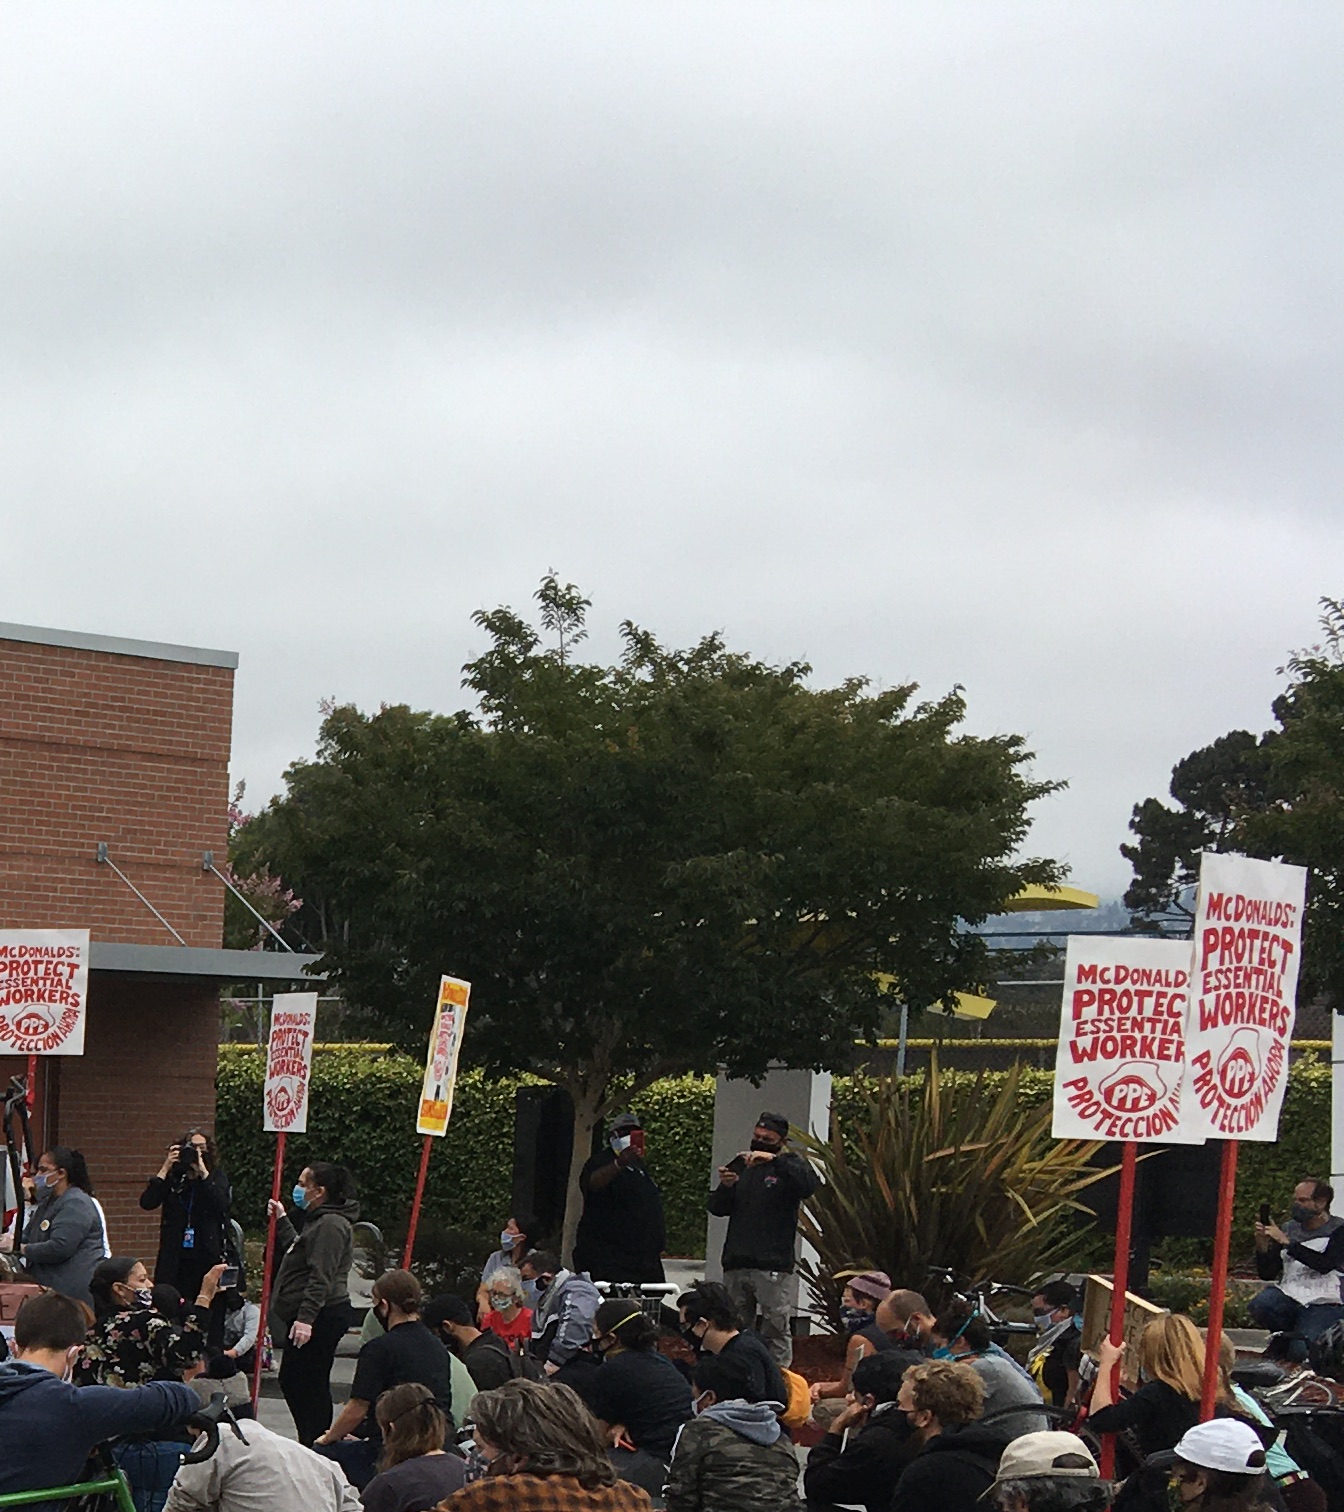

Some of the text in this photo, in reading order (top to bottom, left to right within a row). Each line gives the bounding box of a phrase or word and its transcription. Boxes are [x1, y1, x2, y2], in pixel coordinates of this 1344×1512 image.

[1200, 926, 1293, 975] PROTECT
[1202, 967, 1283, 999] ESSENTIAL
[1072, 988, 1186, 1021] PROTEC
[1199, 991, 1291, 1038] WORKERS
[1075, 1016, 1183, 1038] ESSENTIA
[1224, 1058, 1253, 1091] PPE
[1112, 1083, 1152, 1105] PPE
